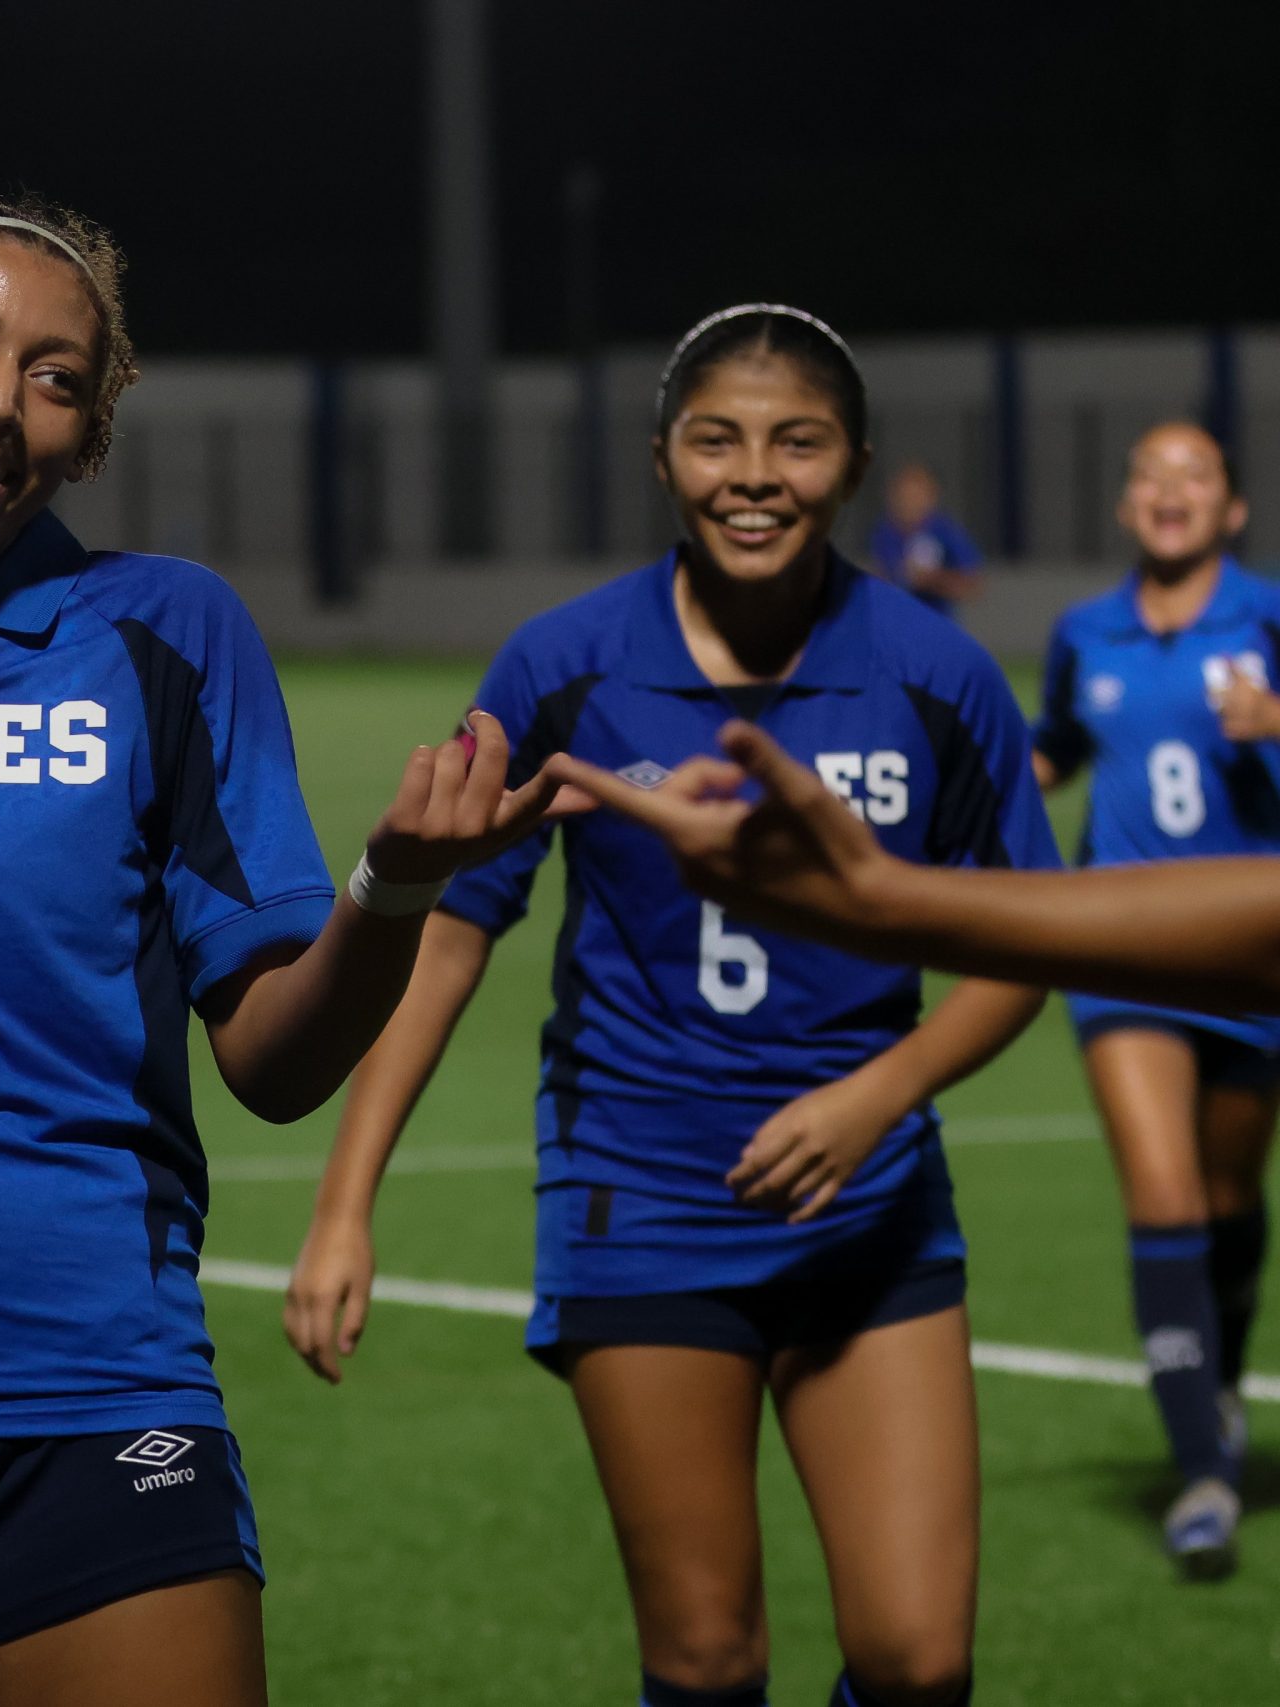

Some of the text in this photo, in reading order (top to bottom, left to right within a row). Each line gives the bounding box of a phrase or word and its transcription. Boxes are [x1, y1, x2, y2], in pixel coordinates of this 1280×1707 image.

[814, 750, 909, 825] ES
[1148, 740, 1205, 838] 8
[698, 900, 769, 1014] 6
[132, 1467, 196, 1493] umbro
